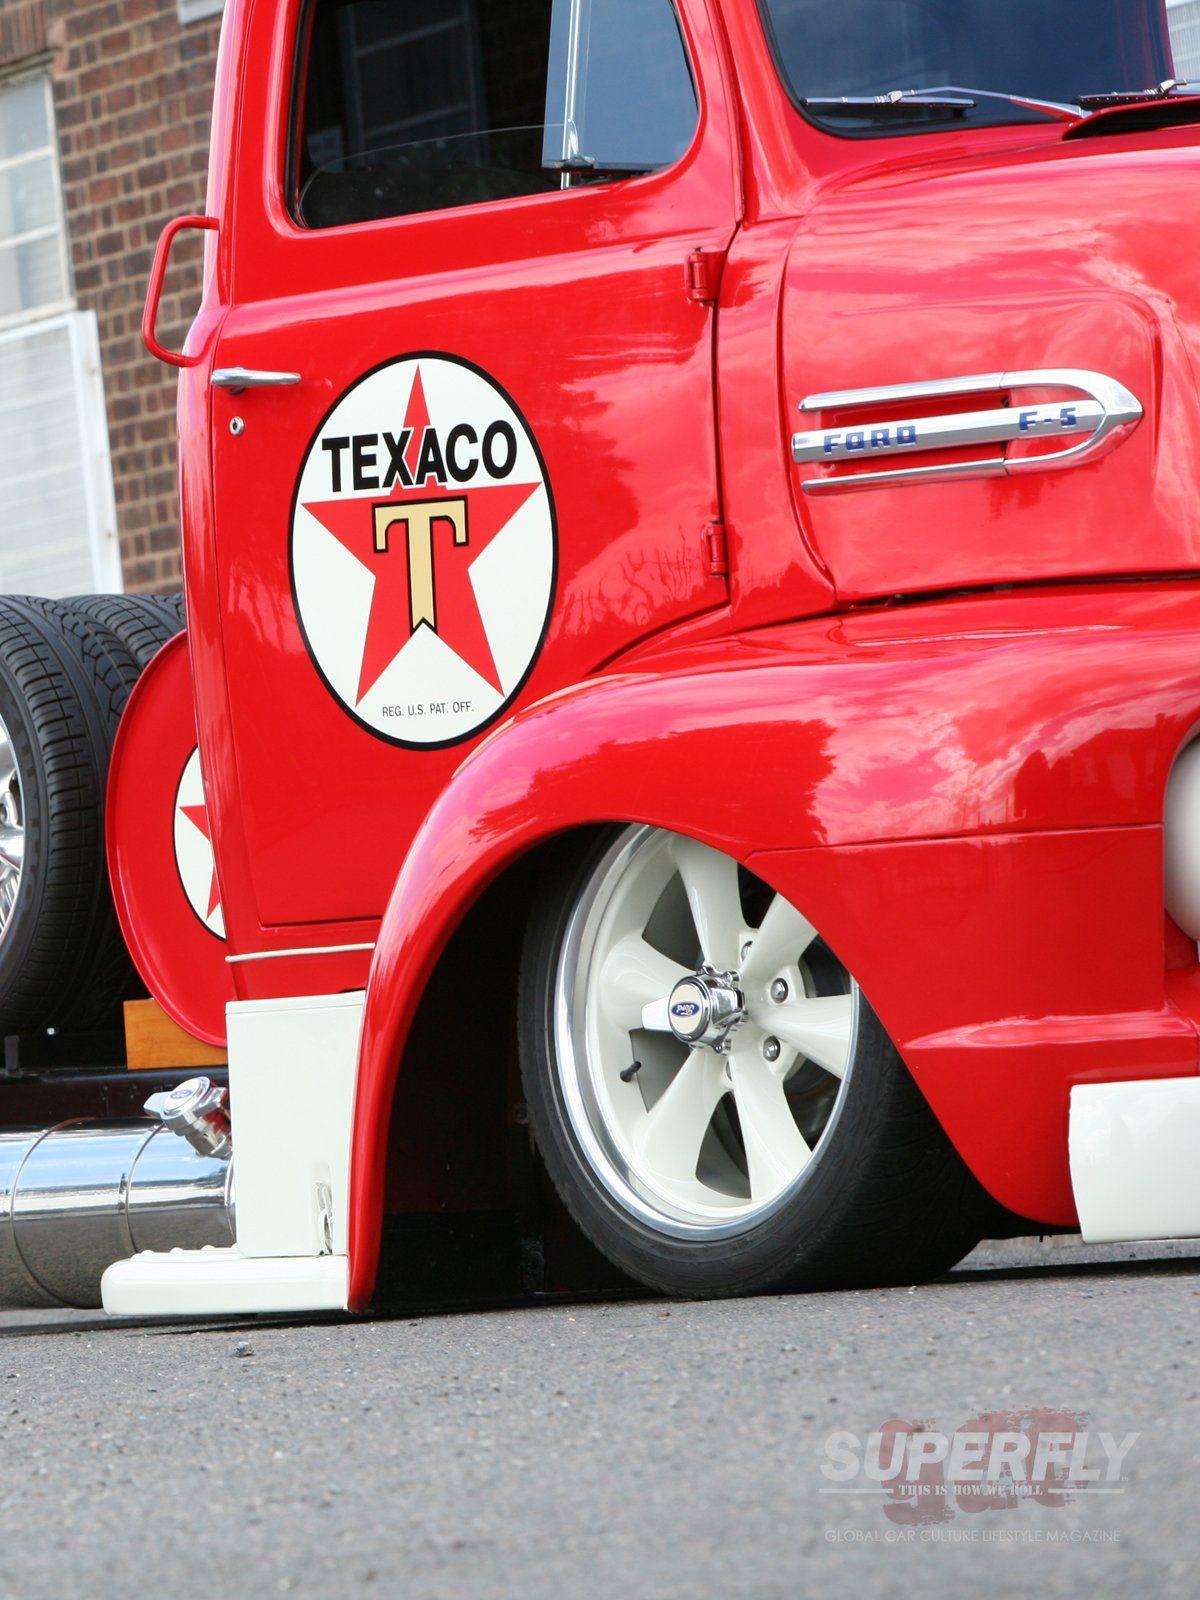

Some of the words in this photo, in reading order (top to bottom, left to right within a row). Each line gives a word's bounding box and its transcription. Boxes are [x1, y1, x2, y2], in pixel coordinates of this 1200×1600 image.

[321, 419, 518, 493] TEXACO
[823, 425, 916, 455] FORD
[1018, 407, 1077, 431] F-5
[372, 495, 469, 637] T
[382, 706, 404, 717] REG.
[407, 704, 427, 716] U.S.
[429, 702, 449, 714] PAT.
[452, 701, 475, 713] OFF.
